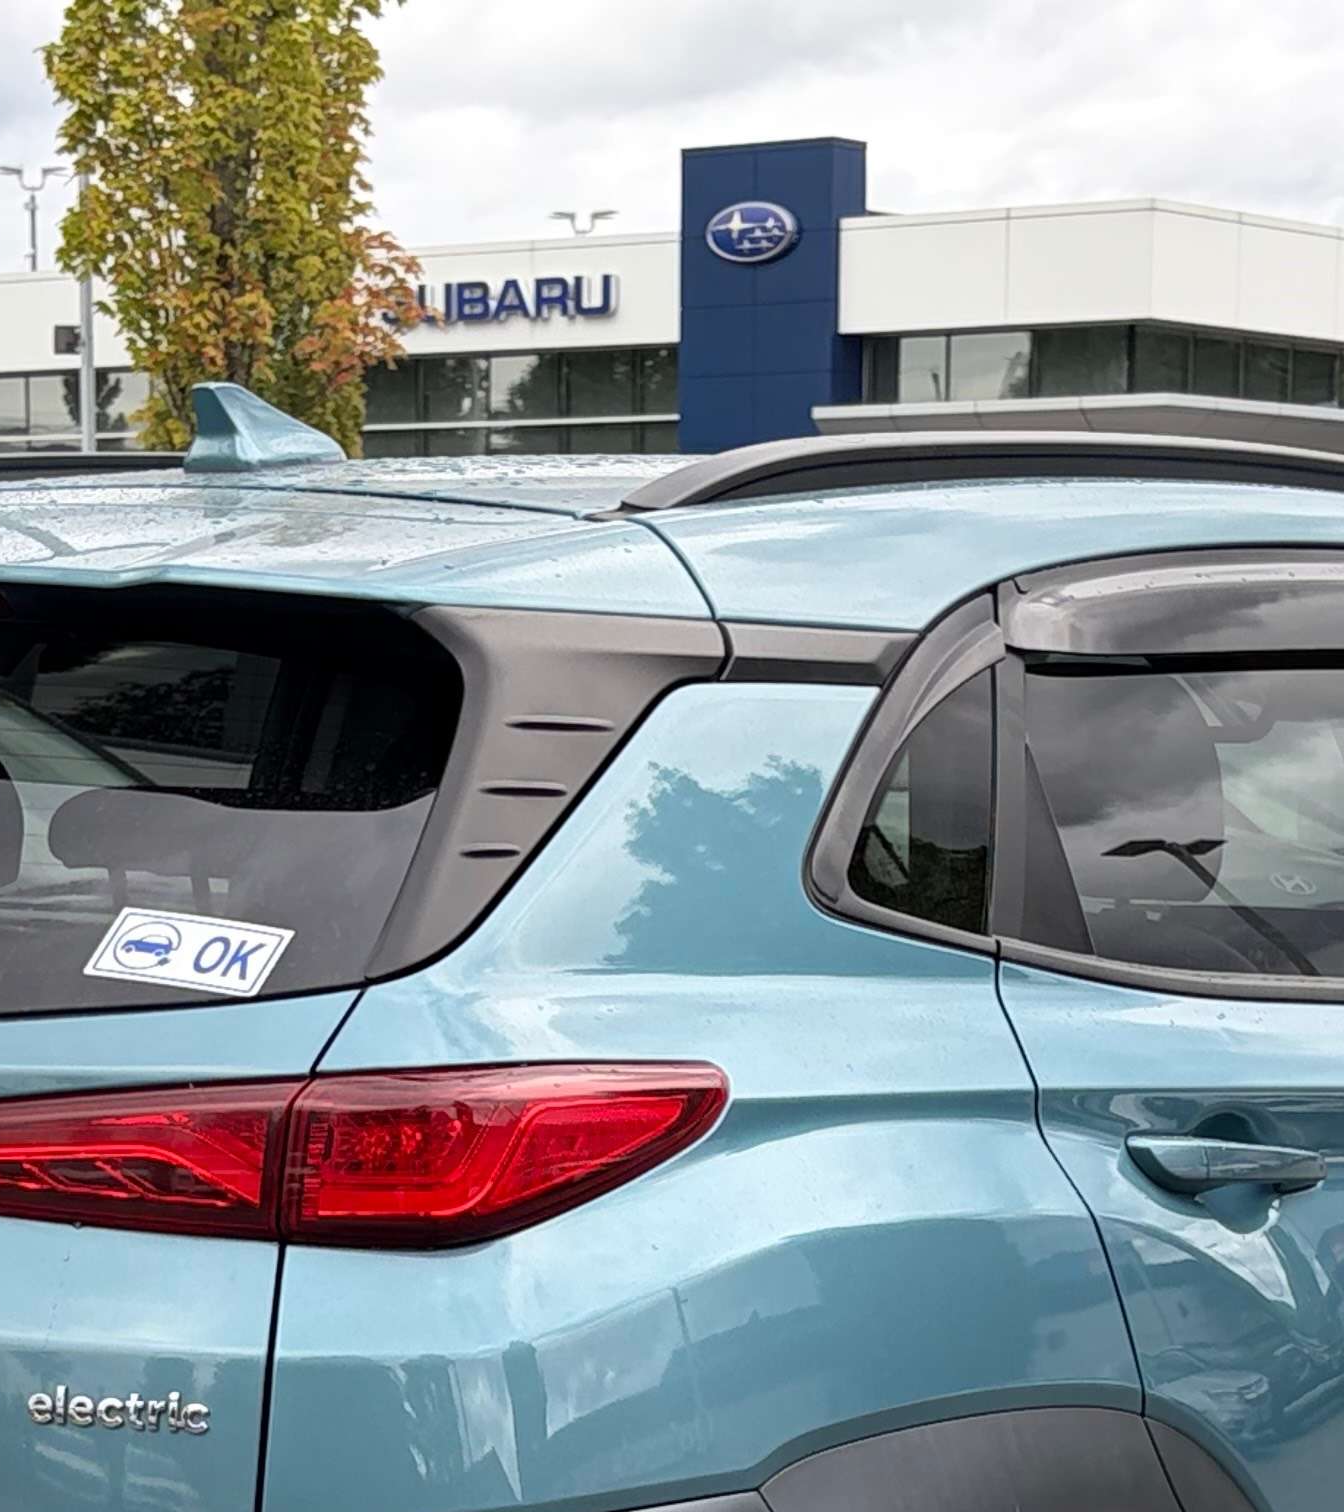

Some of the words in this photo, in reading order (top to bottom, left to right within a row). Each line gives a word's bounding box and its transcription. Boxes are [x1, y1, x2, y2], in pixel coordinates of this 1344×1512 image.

[382, 274, 613, 324] UBARU
[193, 936, 267, 980] OK
[28, 1384, 209, 1434] electric
